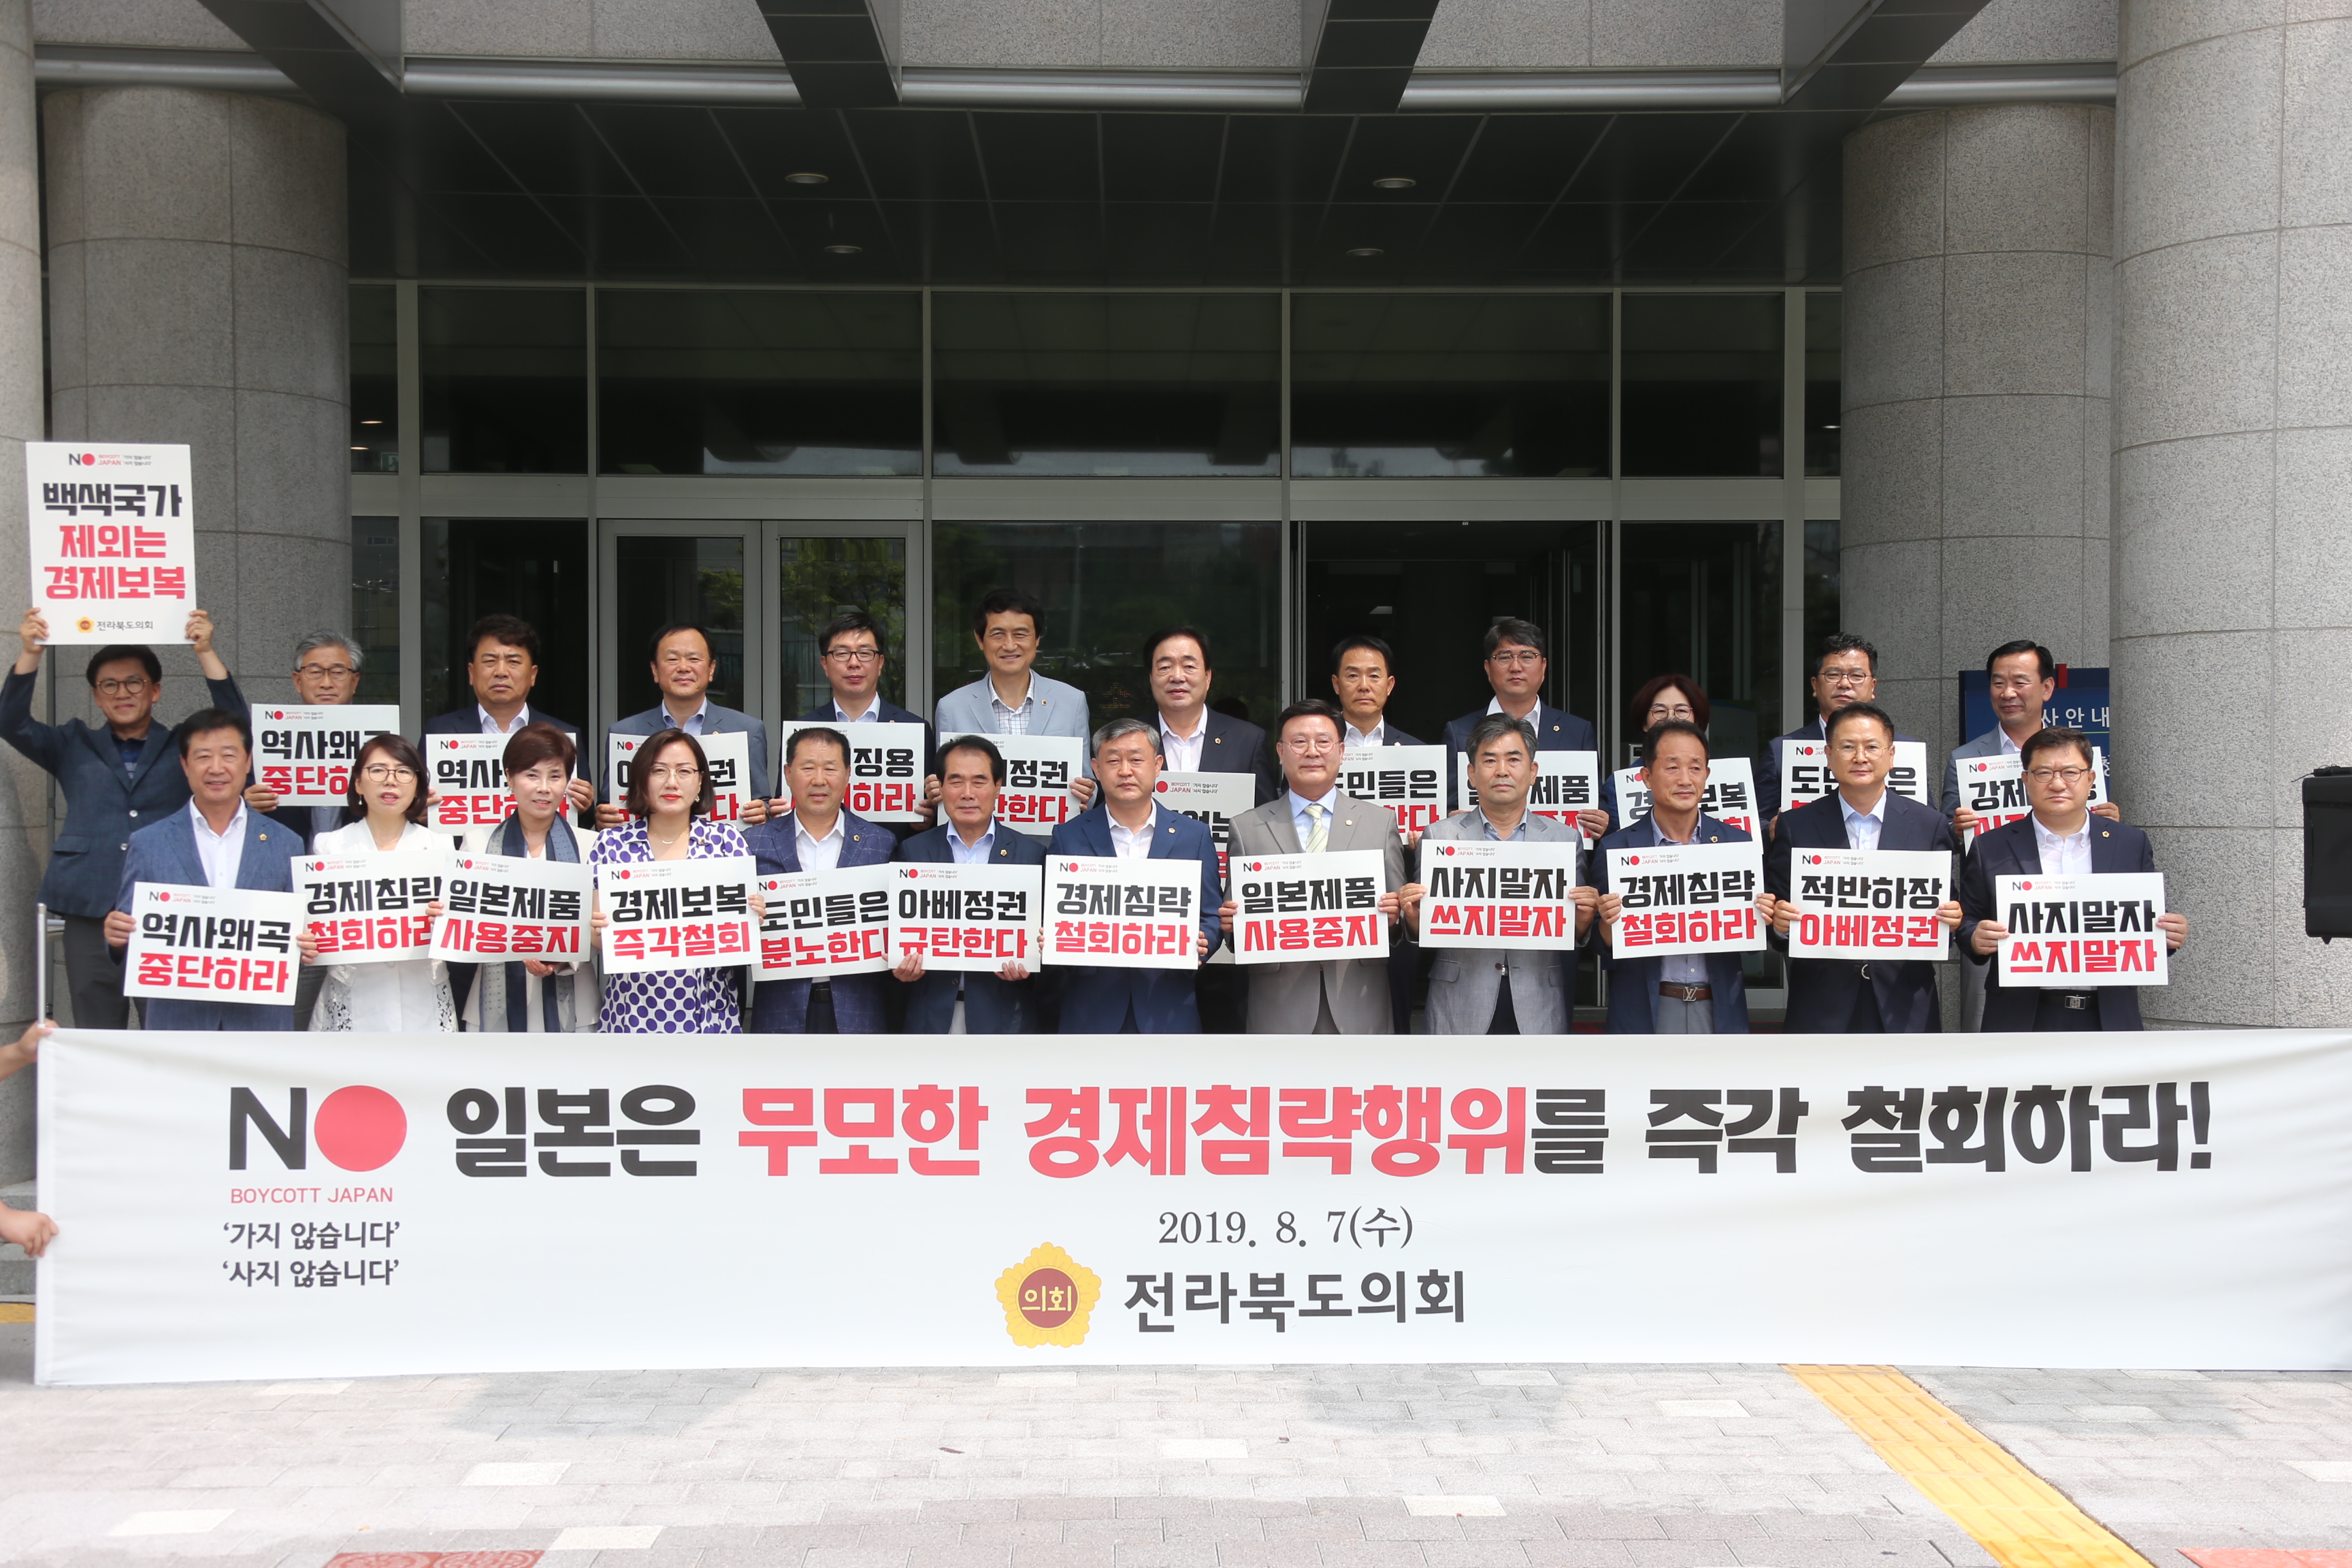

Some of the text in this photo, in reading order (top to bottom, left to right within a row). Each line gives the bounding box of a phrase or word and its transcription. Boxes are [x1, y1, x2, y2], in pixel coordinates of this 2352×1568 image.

[43, 483, 182, 517] 백색국가
[60, 525, 167, 558] 제외는
[44, 566, 186, 599] 경제보복
[97, 621, 153, 631] 전라북도의회
[261, 730, 391, 760] 역사왜
[437, 760, 508, 788] 역사
[847, 749, 914, 777] 징용
[1003, 760, 1068, 789] 정권
[305, 877, 442, 915] 경제침략
[449, 880, 581, 920] 일본제품
[1057, 883, 1192, 917] 경제침략
[1242, 877, 1375, 914] 일본제품
[1430, 867, 1567, 899] 사지말자
[1620, 870, 1754, 908] 경제침략
[1801, 876, 1942, 909] 적반하장
[610, 883, 747, 922] 경제보복
[760, 891, 888, 931] 도민들은
[899, 889, 1026, 921] 아베정권
[2008, 900, 2155, 934] 사지말자
[143, 913, 291, 953] 역사왜곡
[440, 919, 580, 953] 사용중지
[1244, 915, 1378, 951] 사용중지
[1430, 905, 1566, 937] 쓰지말자
[1622, 908, 1757, 947] 철회하라
[1800, 915, 1938, 947] 아베정권
[613, 921, 751, 960] 즉각철회
[761, 928, 888, 969] 분노한다
[899, 928, 1027, 958] 규탄한다
[1055, 921, 1190, 956] 철회하라
[138, 953, 289, 992] 중단하라
[2010, 939, 2157, 973] 쓰지말자
[446, 1081, 2212, 1178] 일본은 무모한 경제침략행위를 즉각 철회하라!
[231, 1188, 393, 1204] BOYCOTT JAPAN
[1158, 1205, 1413, 1250] 2019. 8. 7(수)
[1022, 1285, 1073, 1313] 의회
[1124, 1269, 1464, 1333] 전라북도의회
